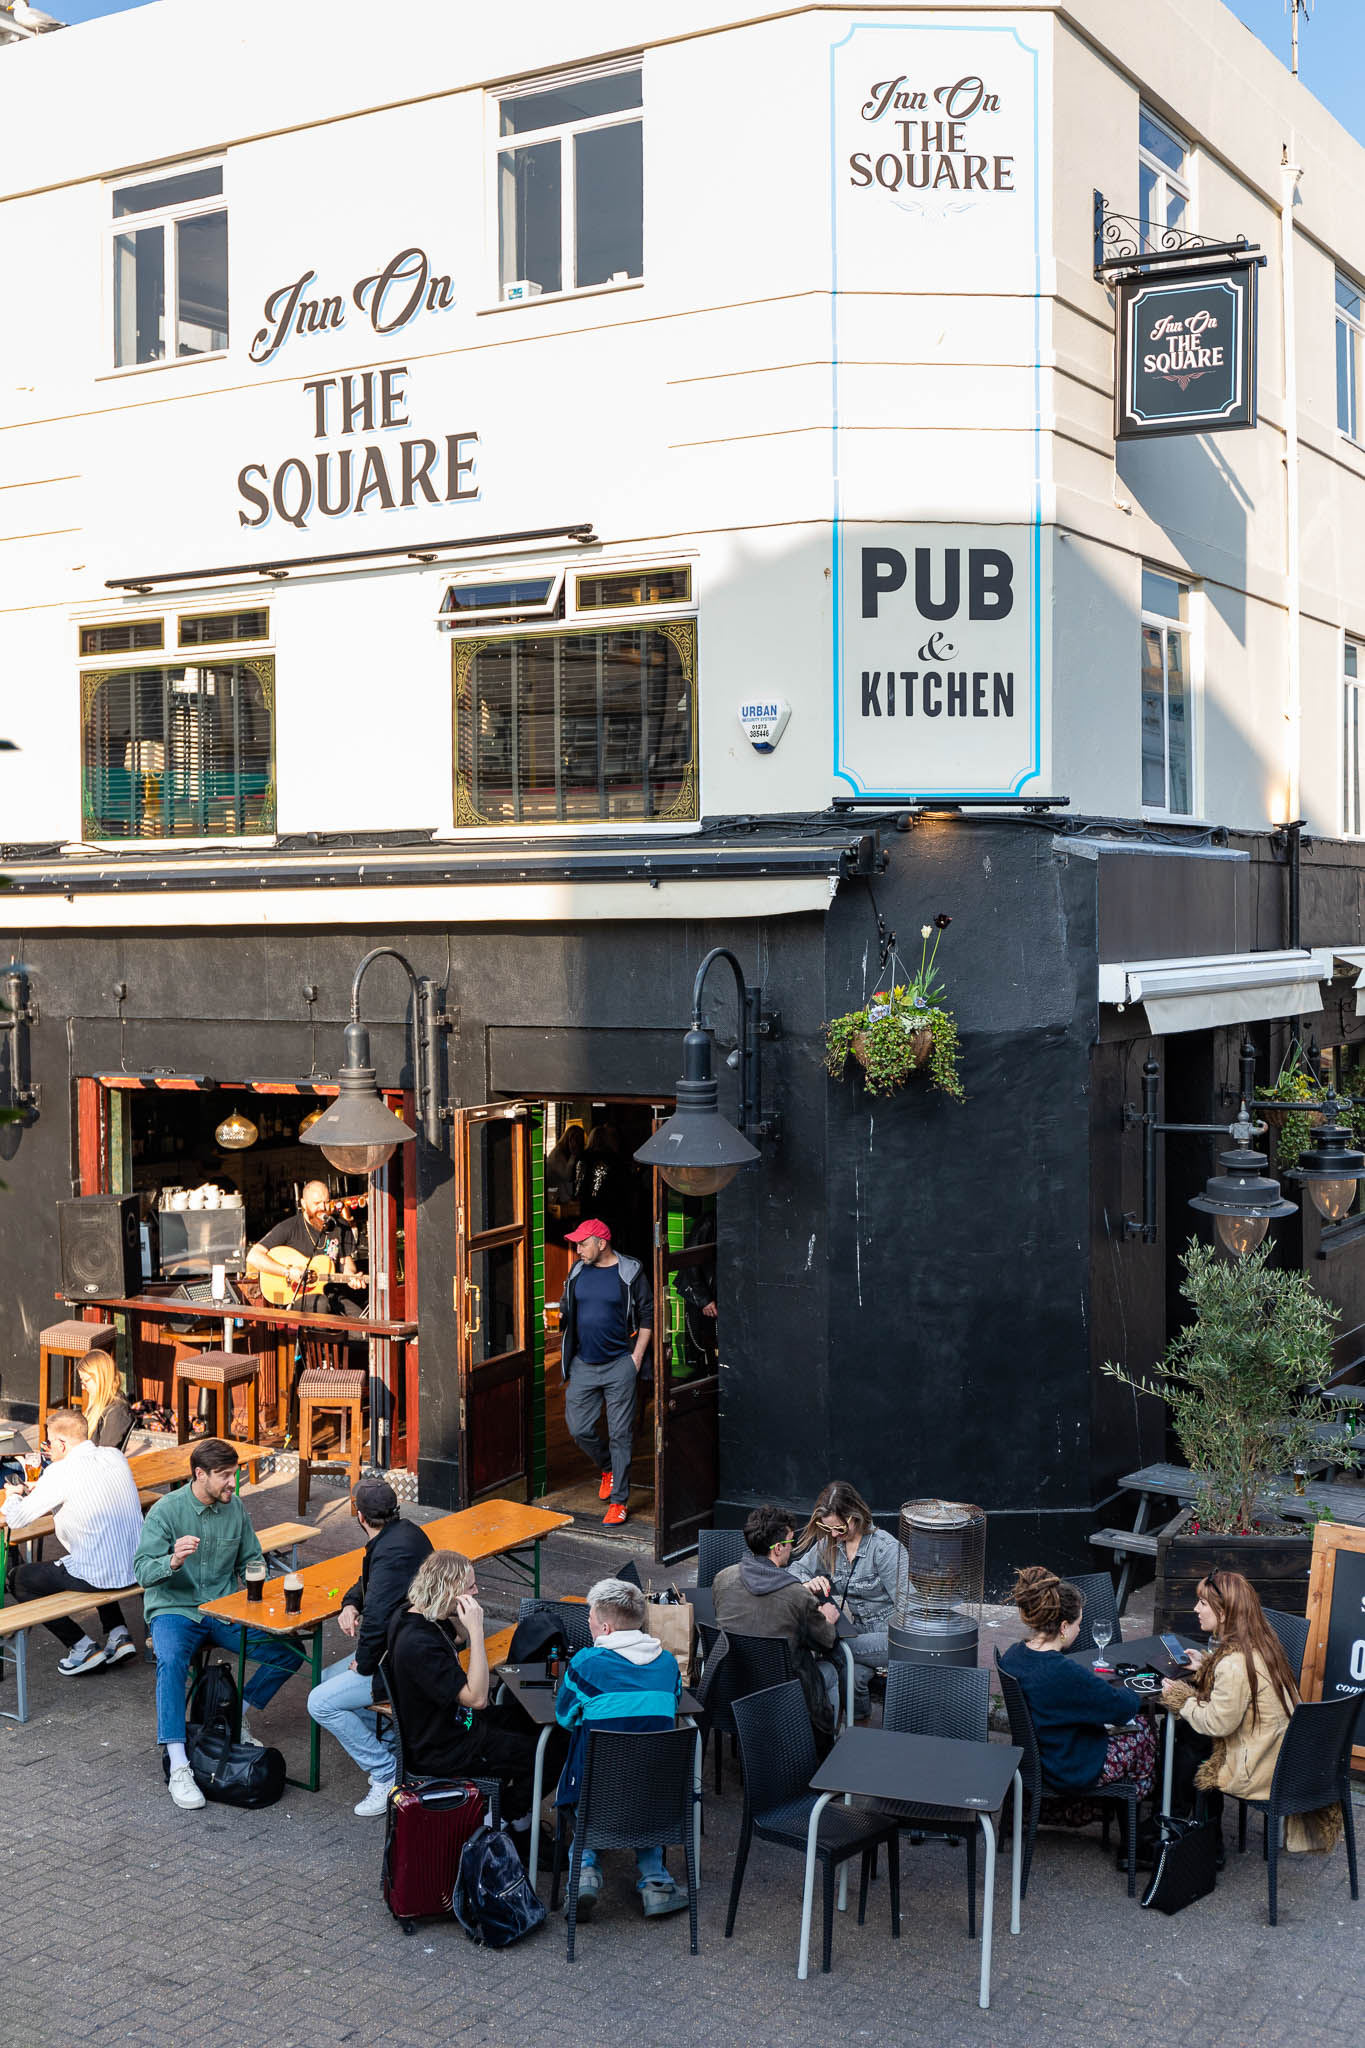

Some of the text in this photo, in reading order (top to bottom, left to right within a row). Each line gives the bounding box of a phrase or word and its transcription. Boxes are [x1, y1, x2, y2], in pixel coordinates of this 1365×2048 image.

[861, 76, 1001, 121] Inn On
[894, 120, 967, 153] THE
[849, 152, 1016, 192] SQUARE
[249, 247, 455, 364] Inn On
[1150, 310, 1218, 341] Inn On
[1165, 332, 1203, 353] THE
[1143, 346, 1225, 374] SQUARE
[303, 366, 412, 438] THE
[237, 431, 481, 529] SQUARE
[861, 547, 1014, 621] PUB
[917, 631, 959, 662] &
[742, 705, 777, 717] URBAN
[861, 671, 1014, 717] KITCHEN
[750, 730, 769, 738] 385446
